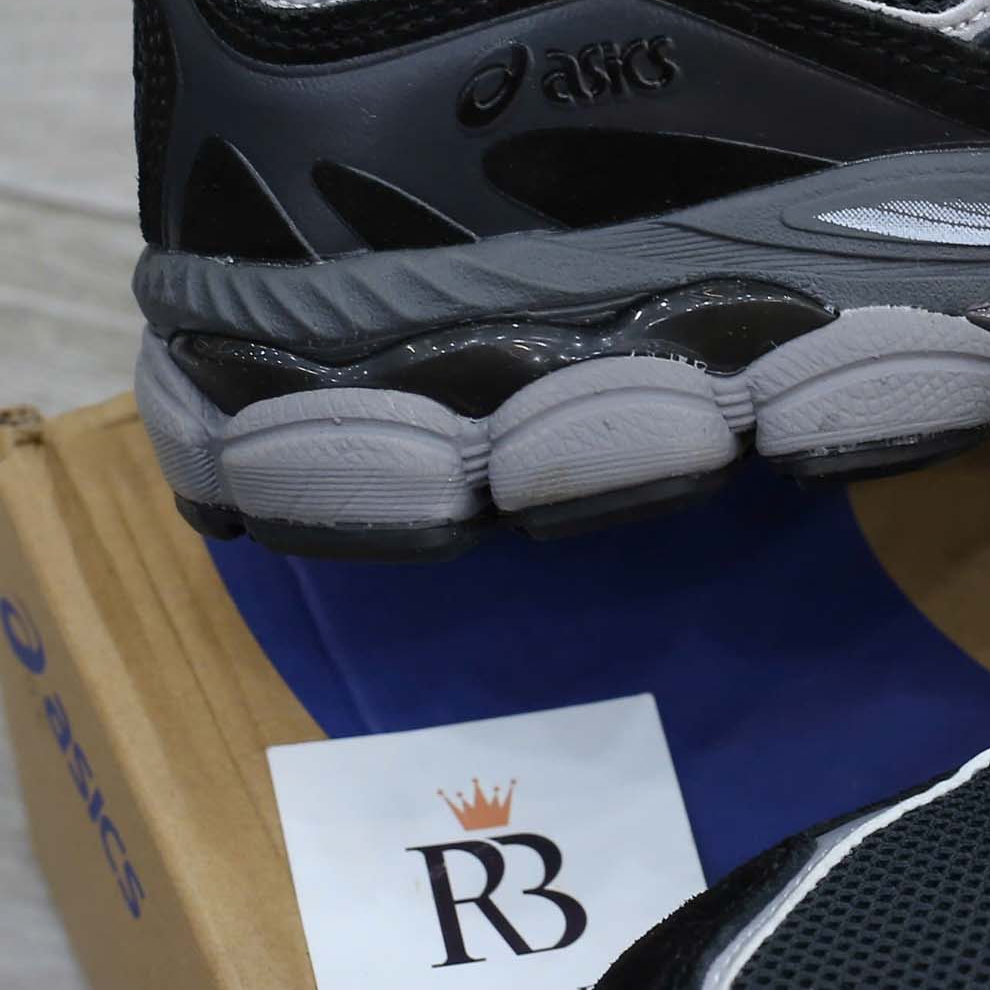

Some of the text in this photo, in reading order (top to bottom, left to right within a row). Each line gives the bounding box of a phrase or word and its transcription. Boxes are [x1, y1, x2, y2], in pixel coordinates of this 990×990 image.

[541, 35, 680, 106] asics
[43, 691, 146, 919] asics
[405, 832, 588, 968] RB
